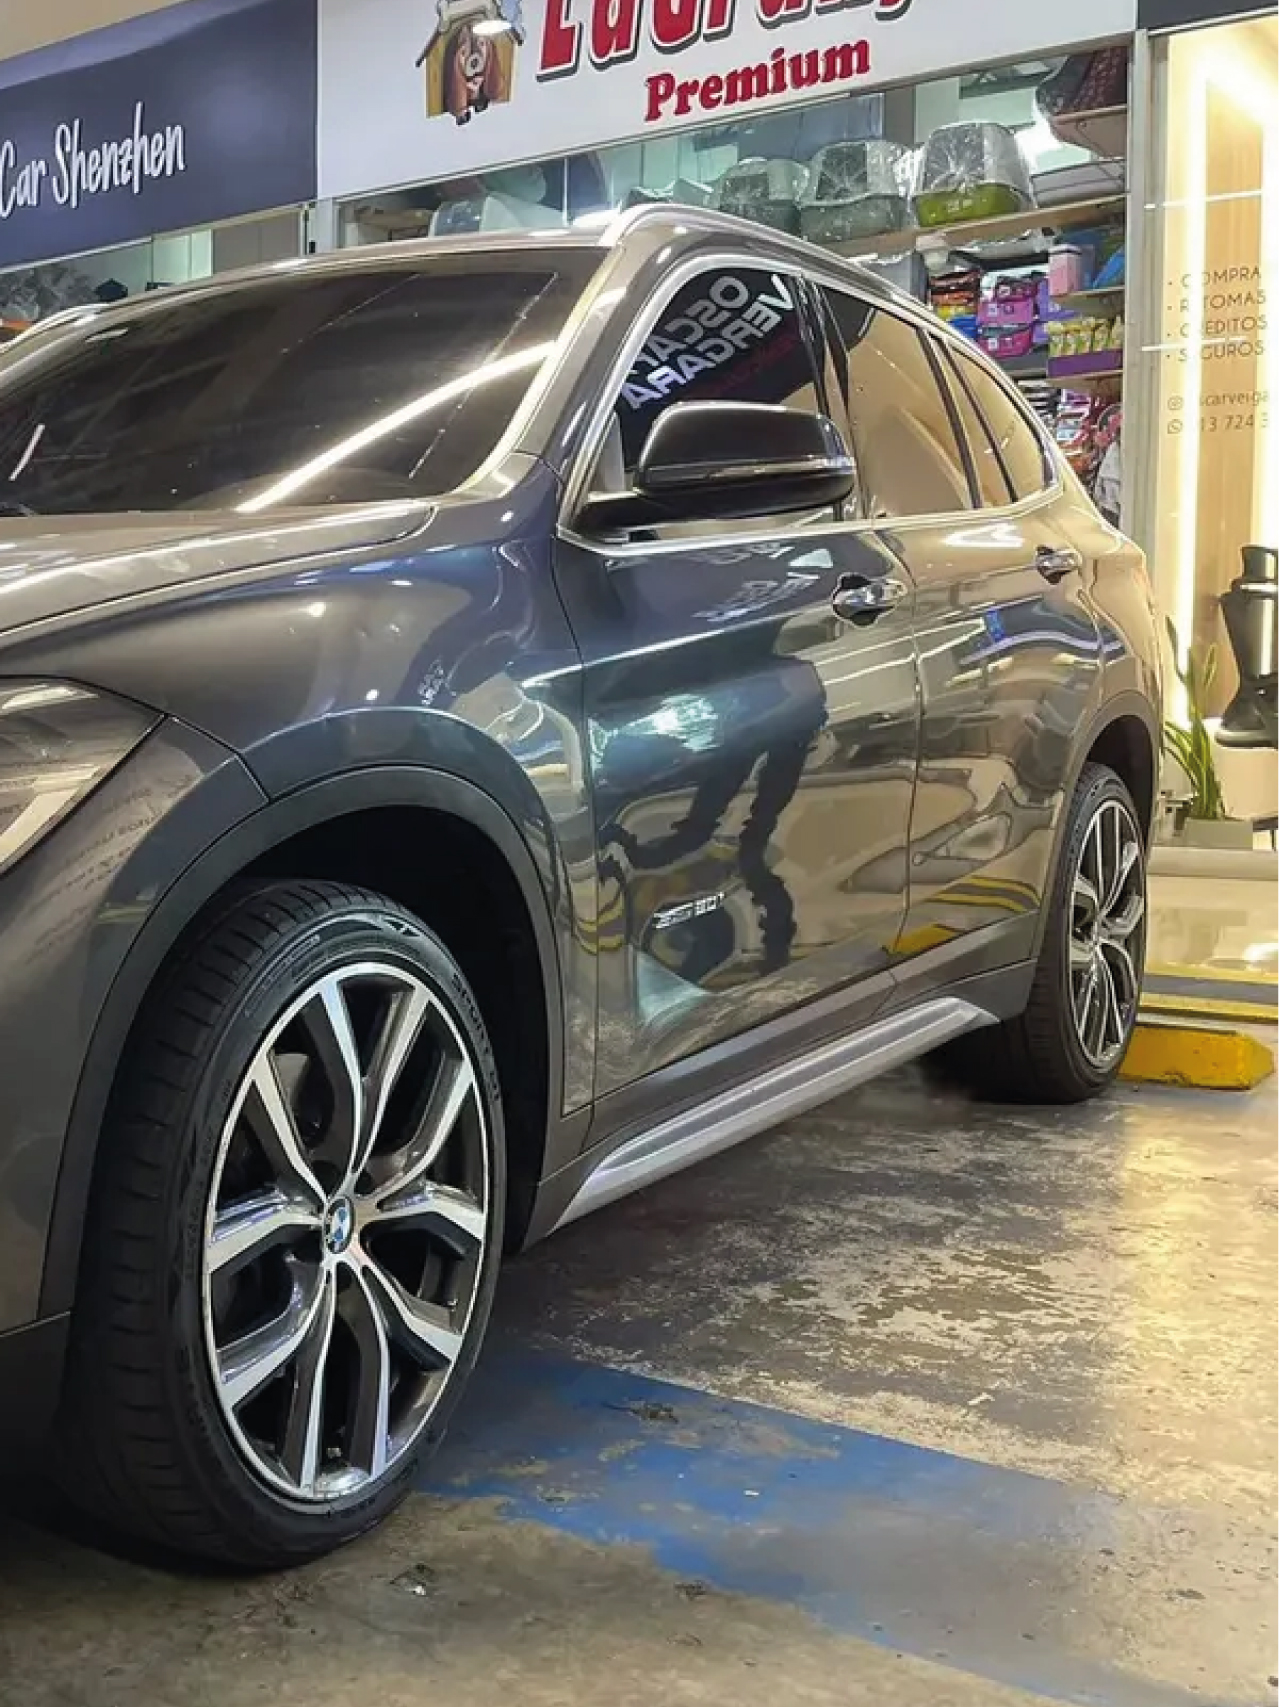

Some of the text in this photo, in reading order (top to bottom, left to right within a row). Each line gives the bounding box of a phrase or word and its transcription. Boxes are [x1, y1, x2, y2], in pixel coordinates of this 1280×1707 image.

[645, 38, 871, 122] Premium
[53, 100, 186, 209] Shenzhen
[1180, 288, 1267, 313] RTOMAS
[1180, 314, 1268, 338] CEDITOS
[1178, 339, 1266, 362] SGUROS
